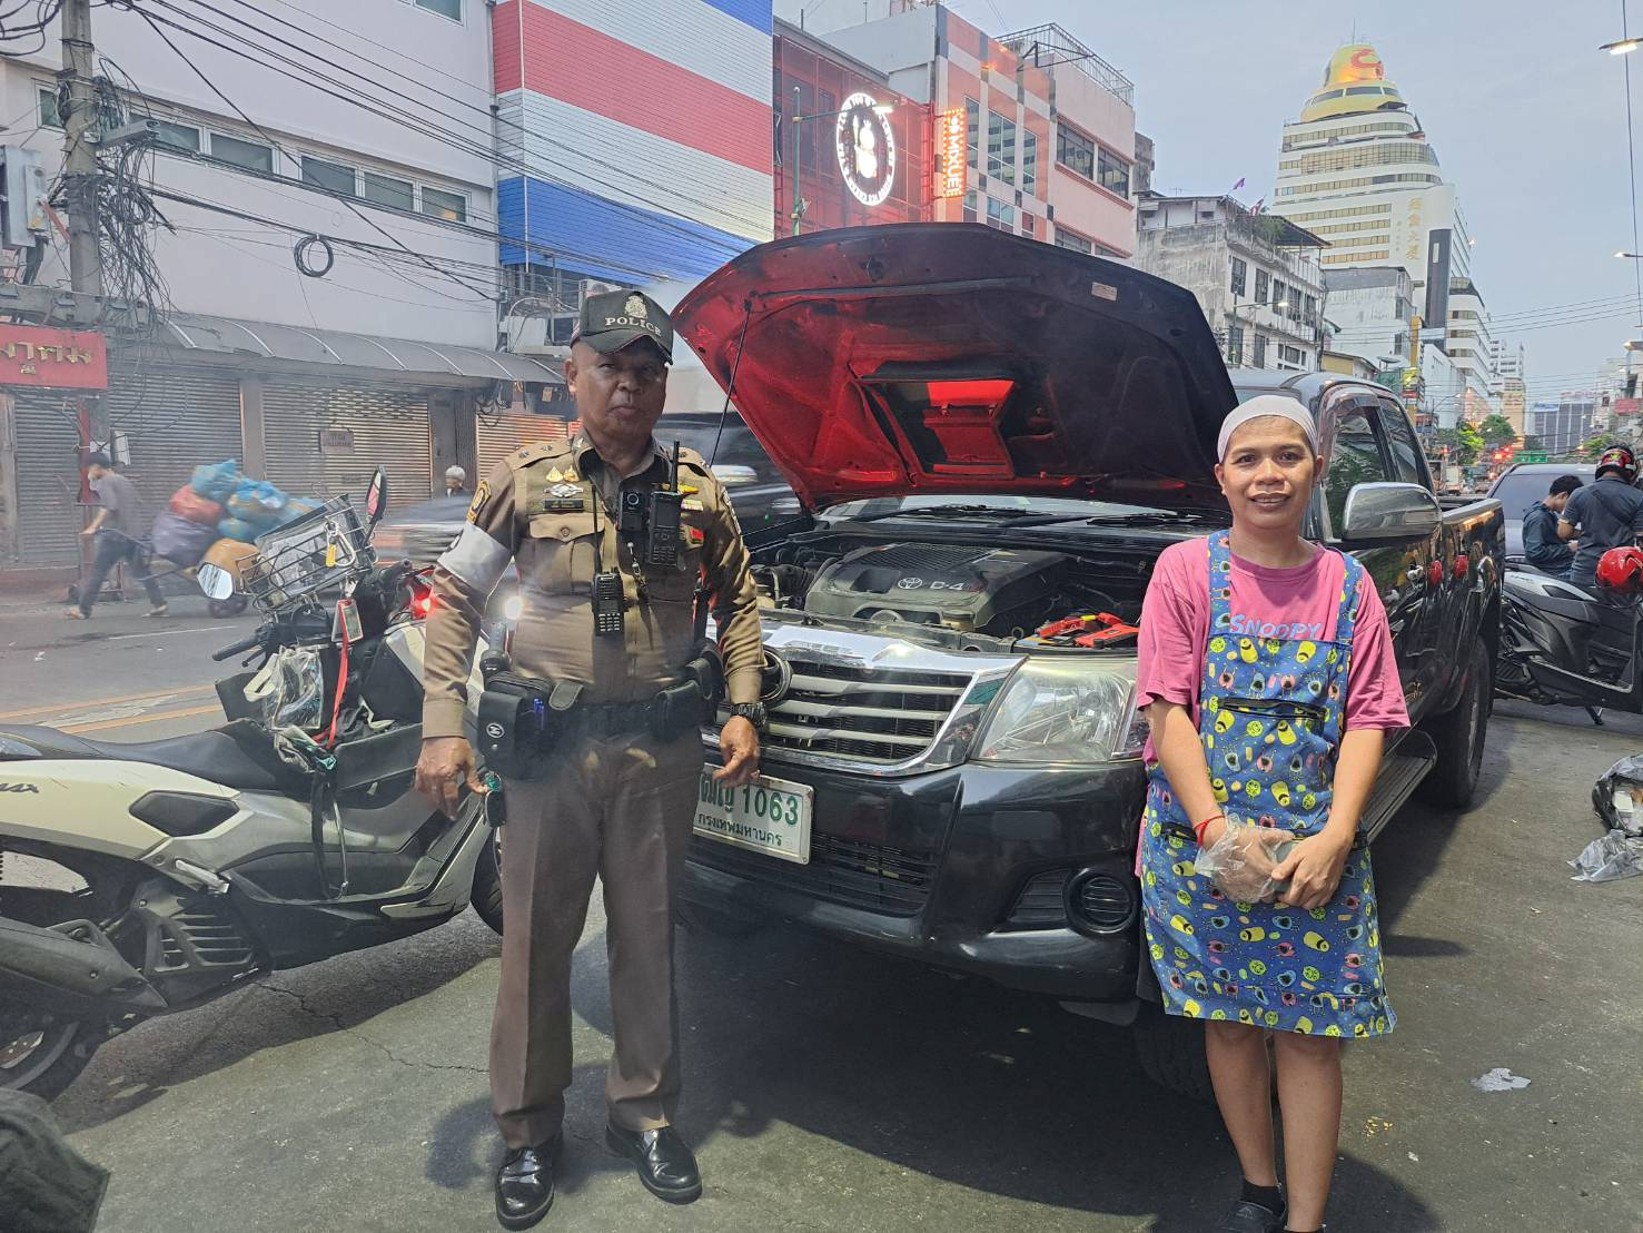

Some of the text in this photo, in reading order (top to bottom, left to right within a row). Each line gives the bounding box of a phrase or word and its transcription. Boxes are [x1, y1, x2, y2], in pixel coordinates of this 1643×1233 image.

[947, 136, 960, 190] MIXUE
[604, 316, 662, 337] POLICE
[1229, 613, 1322, 640] SNOOPY
[743, 783, 799, 826] 1063
